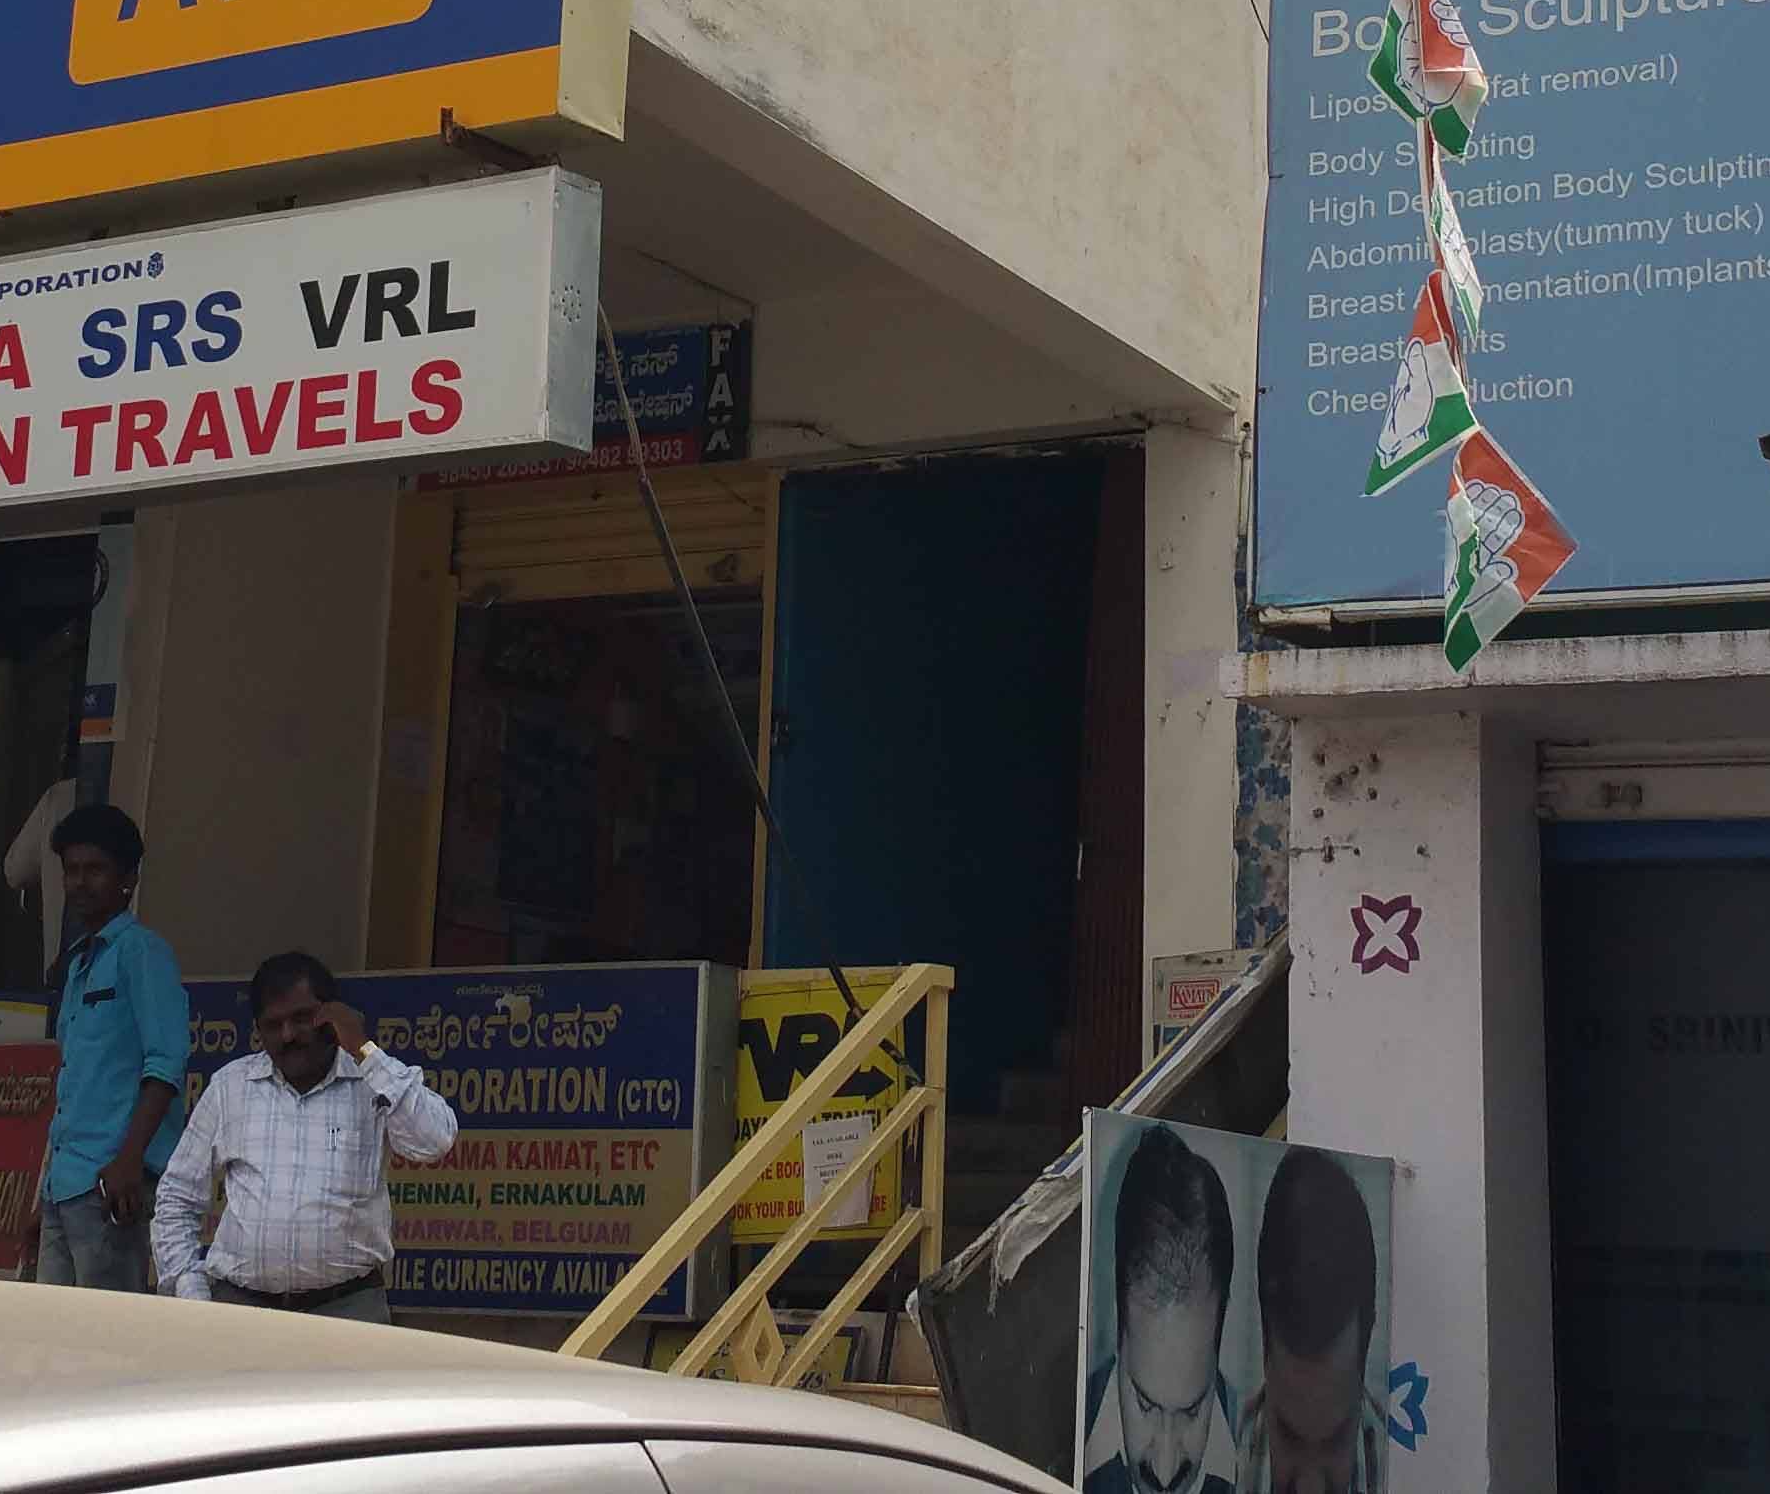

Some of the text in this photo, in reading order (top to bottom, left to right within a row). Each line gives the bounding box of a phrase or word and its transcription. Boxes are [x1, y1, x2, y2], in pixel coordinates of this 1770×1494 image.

[1541, 53, 1677, 93] removal)
[1309, 147, 1383, 175] Body
[1309, 194, 1374, 225] High
[1554, 168, 1632, 198] Body
[1683, 203, 1763, 234] tuck)
[77, 291, 244, 380] SRS
[300, 259, 477, 352] VRL
[1309, 287, 1405, 319] Breast
[60, 358, 465, 479] TRAVELS
[617, 1077, 682, 1121] (CTC)
[505, 1138, 662, 1176] KAMAT, ETC
[490, 1182, 647, 1207] ERNAKULAM
[512, 1220, 631, 1245] BELGUAM
[431, 1256, 548, 1293] CURRENCY
